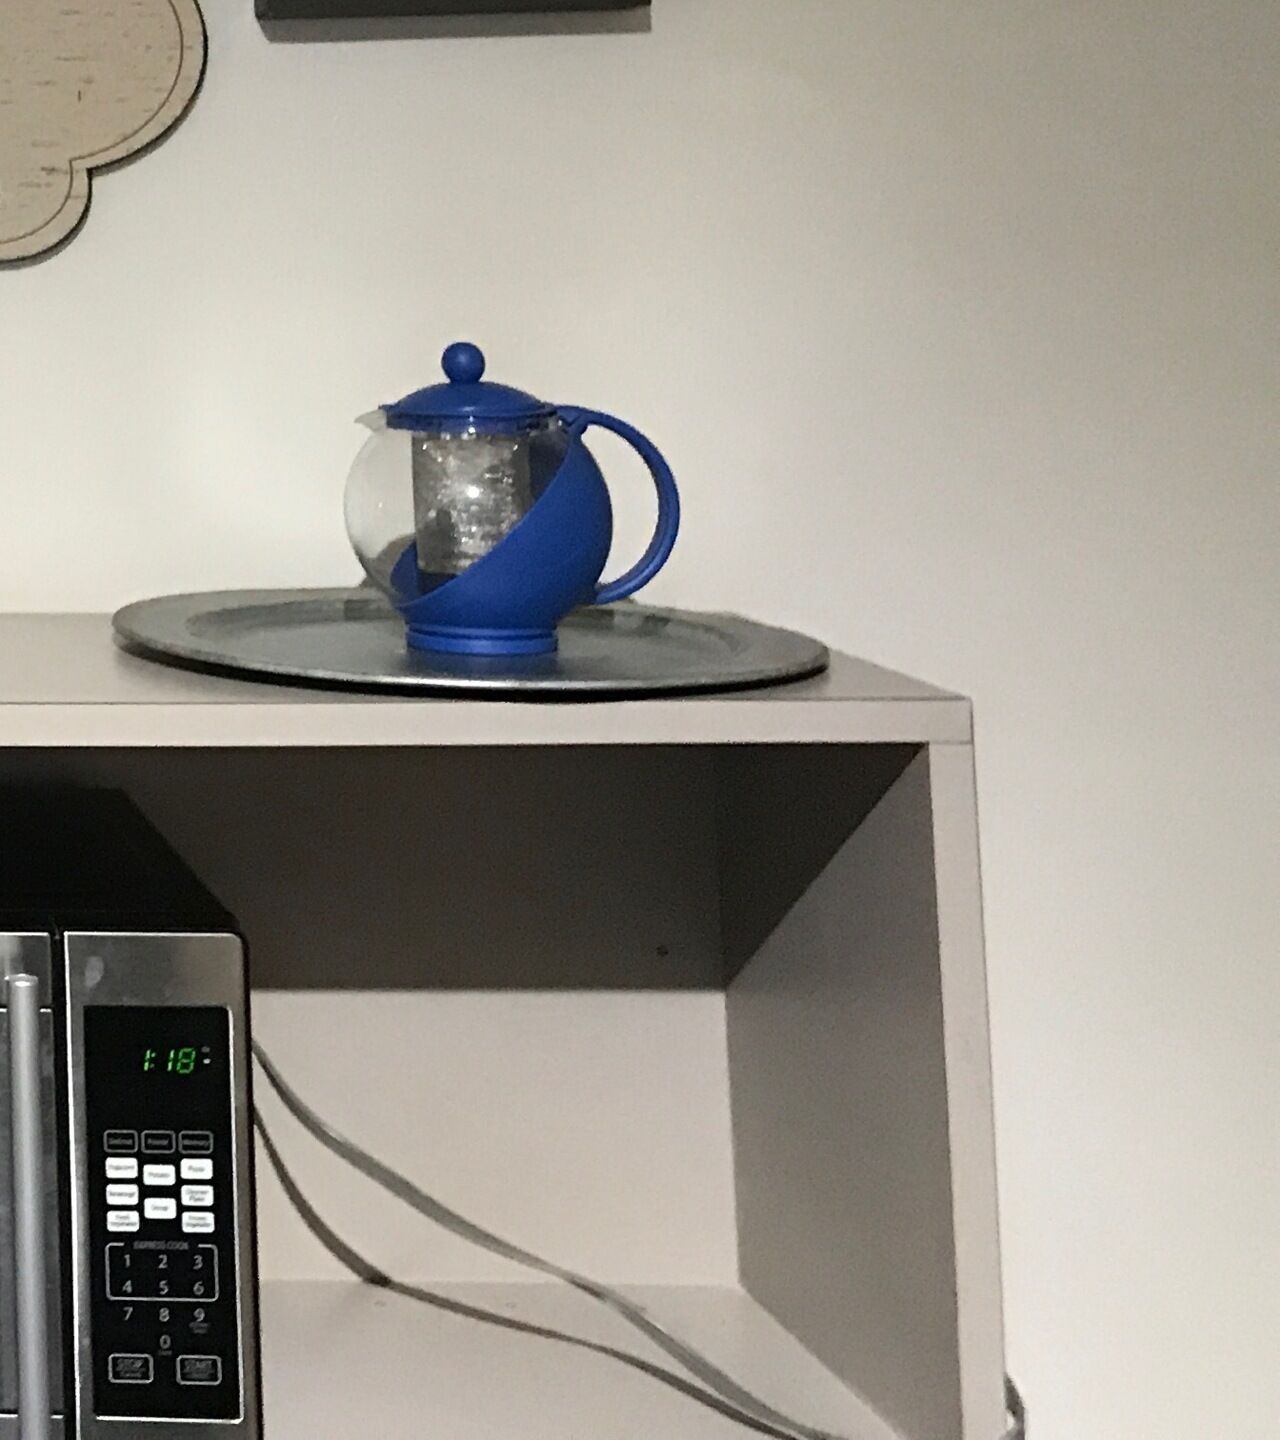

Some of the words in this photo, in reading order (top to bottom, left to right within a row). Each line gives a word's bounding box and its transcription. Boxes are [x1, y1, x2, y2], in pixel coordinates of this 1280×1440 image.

[143, 1047, 196, 1074] 1:18
[123, 1254, 131, 1268] 1
[158, 1254, 168, 1269] 2
[193, 1254, 203, 1270] 3
[122, 1280, 133, 1294] 4
[159, 1280, 169, 1295] 5
[193, 1281, 205, 1296] 6
[123, 1306, 134, 1321] 7
[159, 1307, 170, 1322] 8
[193, 1307, 205, 1322] 9
